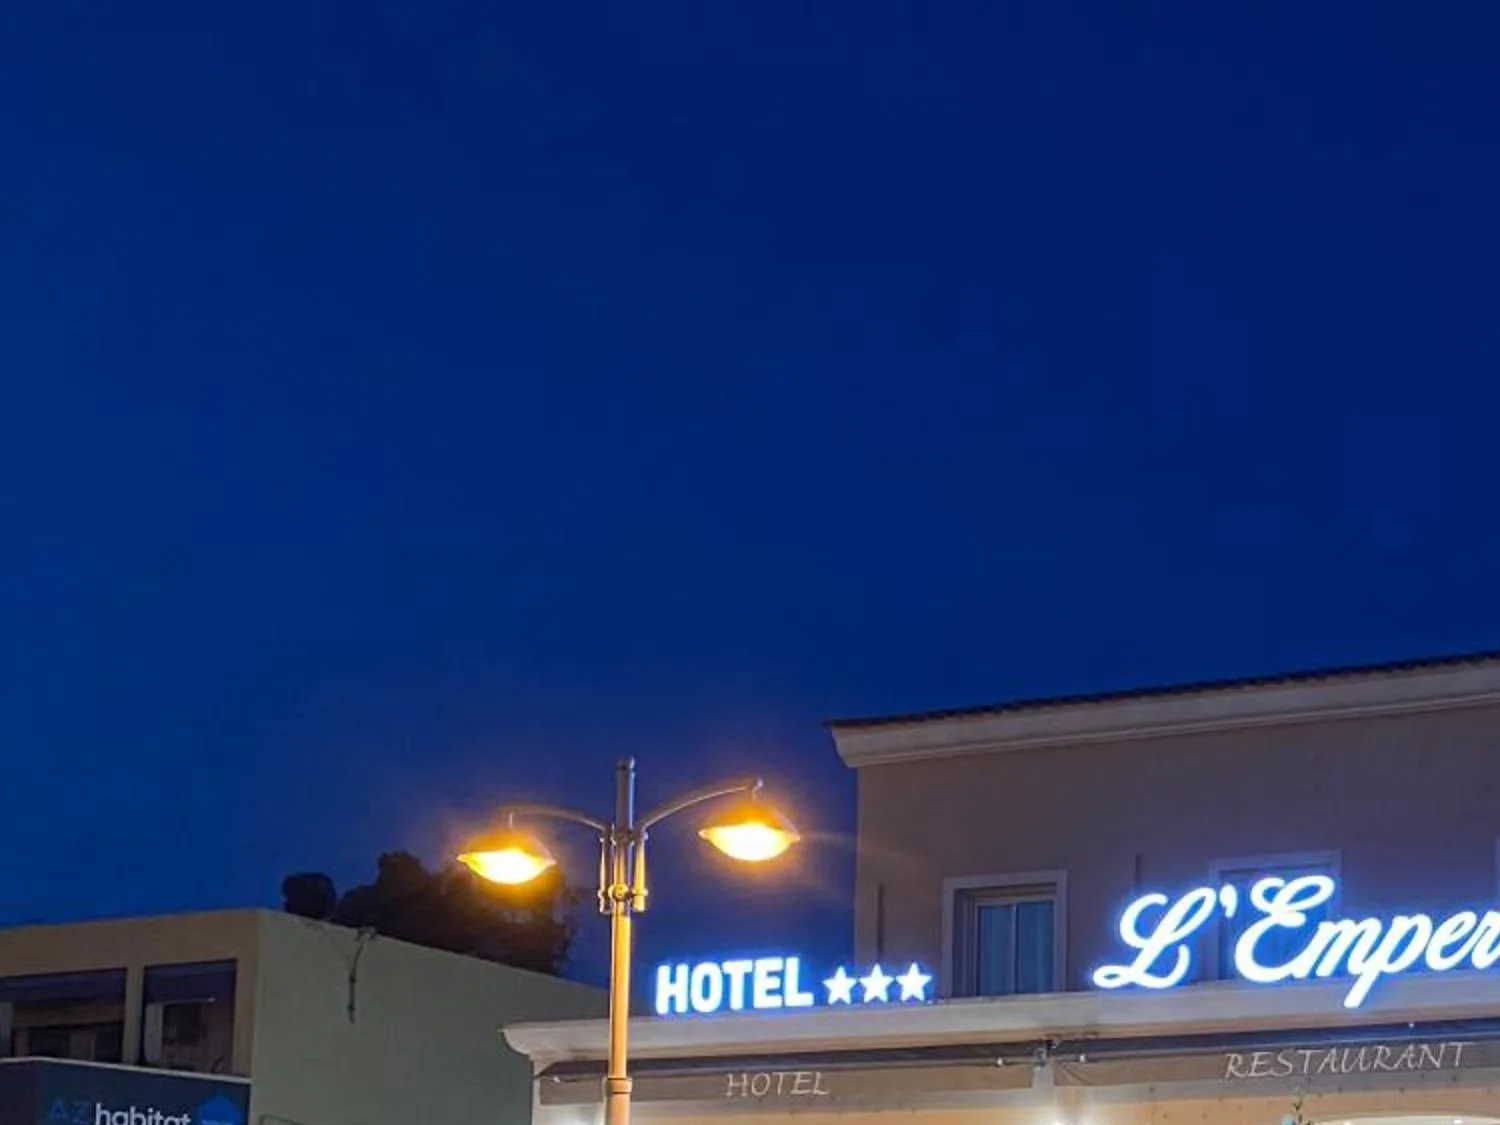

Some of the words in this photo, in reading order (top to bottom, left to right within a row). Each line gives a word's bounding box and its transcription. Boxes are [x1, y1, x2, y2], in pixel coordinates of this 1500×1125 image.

[655, 956, 815, 1015] HOTEL
[1223, 1041, 1470, 1080] RESTAURANT
[725, 1070, 831, 1097] HOTEL
